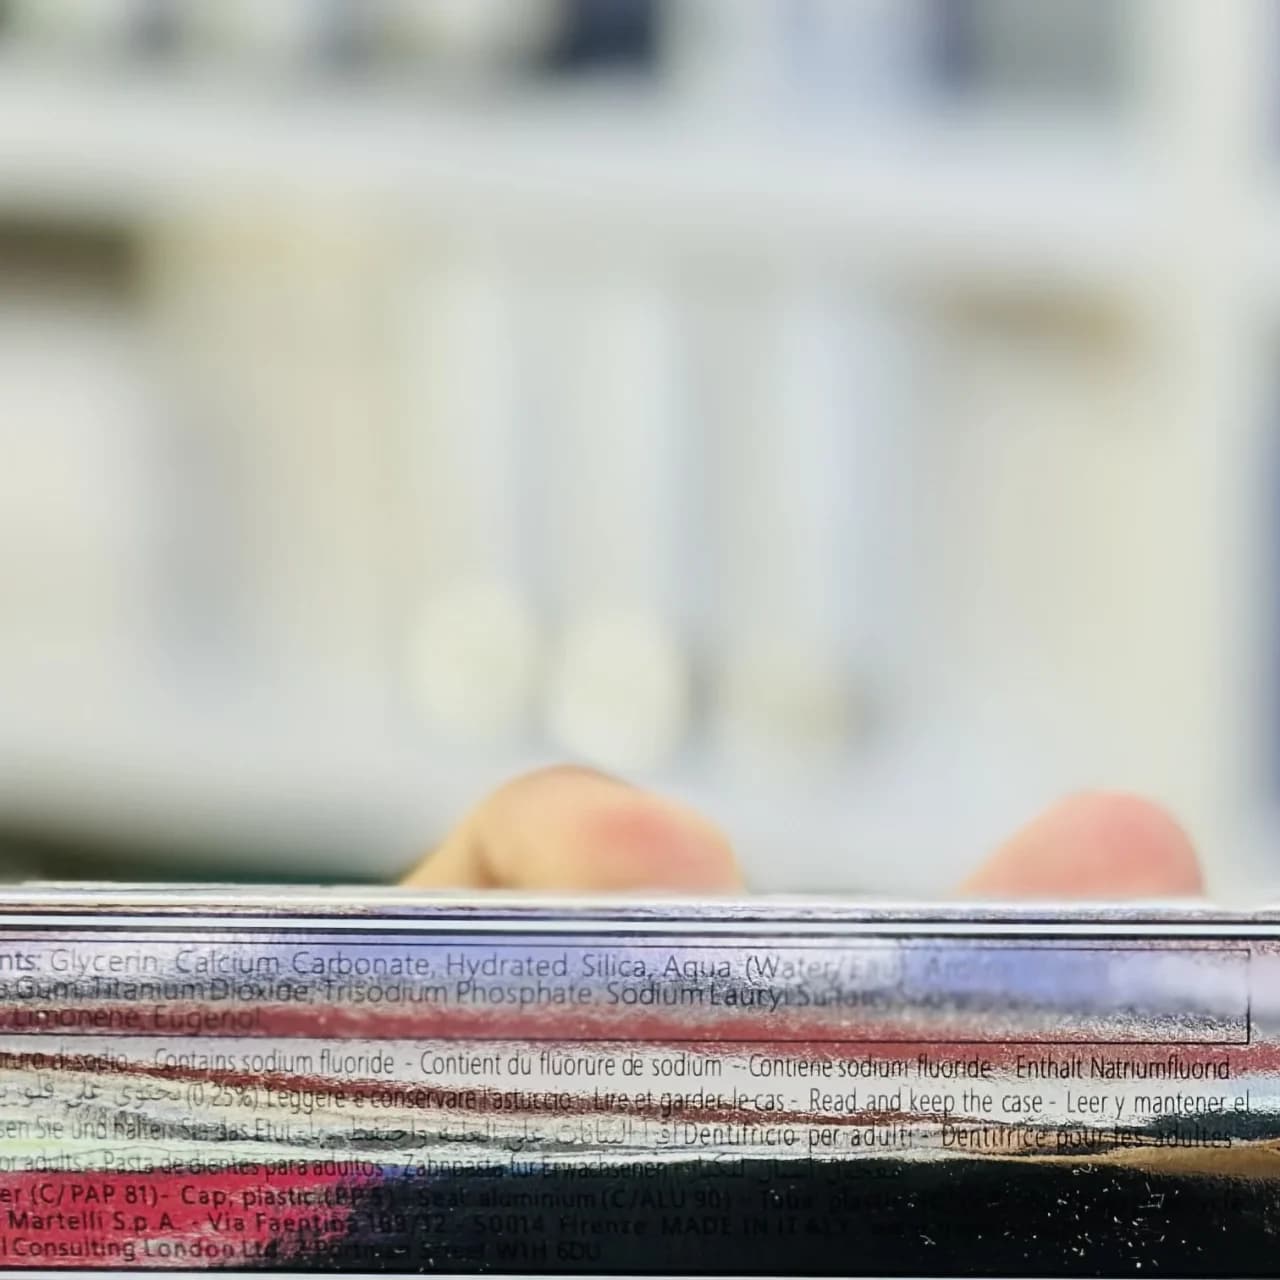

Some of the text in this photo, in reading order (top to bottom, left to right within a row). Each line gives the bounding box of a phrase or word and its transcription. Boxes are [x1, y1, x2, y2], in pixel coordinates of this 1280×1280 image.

[176, 951, 279, 974] Calcium
[293, 952, 435, 977] Carbonate,
[448, 953, 567, 980] Hydrated
[583, 955, 651, 980] Silica,
[664, 955, 730, 984] Aqua
[323, 980, 703, 1005] Trisodium Sodium
[154, 1048, 234, 1073] Contains
[243, 1050, 311, 1073] sodium
[320, 1049, 394, 1075] fluoride
[420, 1051, 501, 1075] Contient
[507, 1051, 532, 1075] du
[541, 1051, 615, 1077] fluorure
[622, 1053, 644, 1077] de
[652, 1053, 722, 1077] sodium
[750, 1054, 832, 1078] Contiene
[839, 1054, 908, 1079] sodium
[917, 1054, 992, 1079] fluoride
[1091, 1055, 1230, 1081] Natriumfluorid
[660, 1087, 1250, 1120] garder le cas Read and keep the case Leer y mantener el
[809, 1126, 839, 1154] per
[31, 1183, 116, 1208] (C/PAP
[8, 1210, 246, 1232] Martelli Via
[13, 1237, 235, 1261] Consulting London
